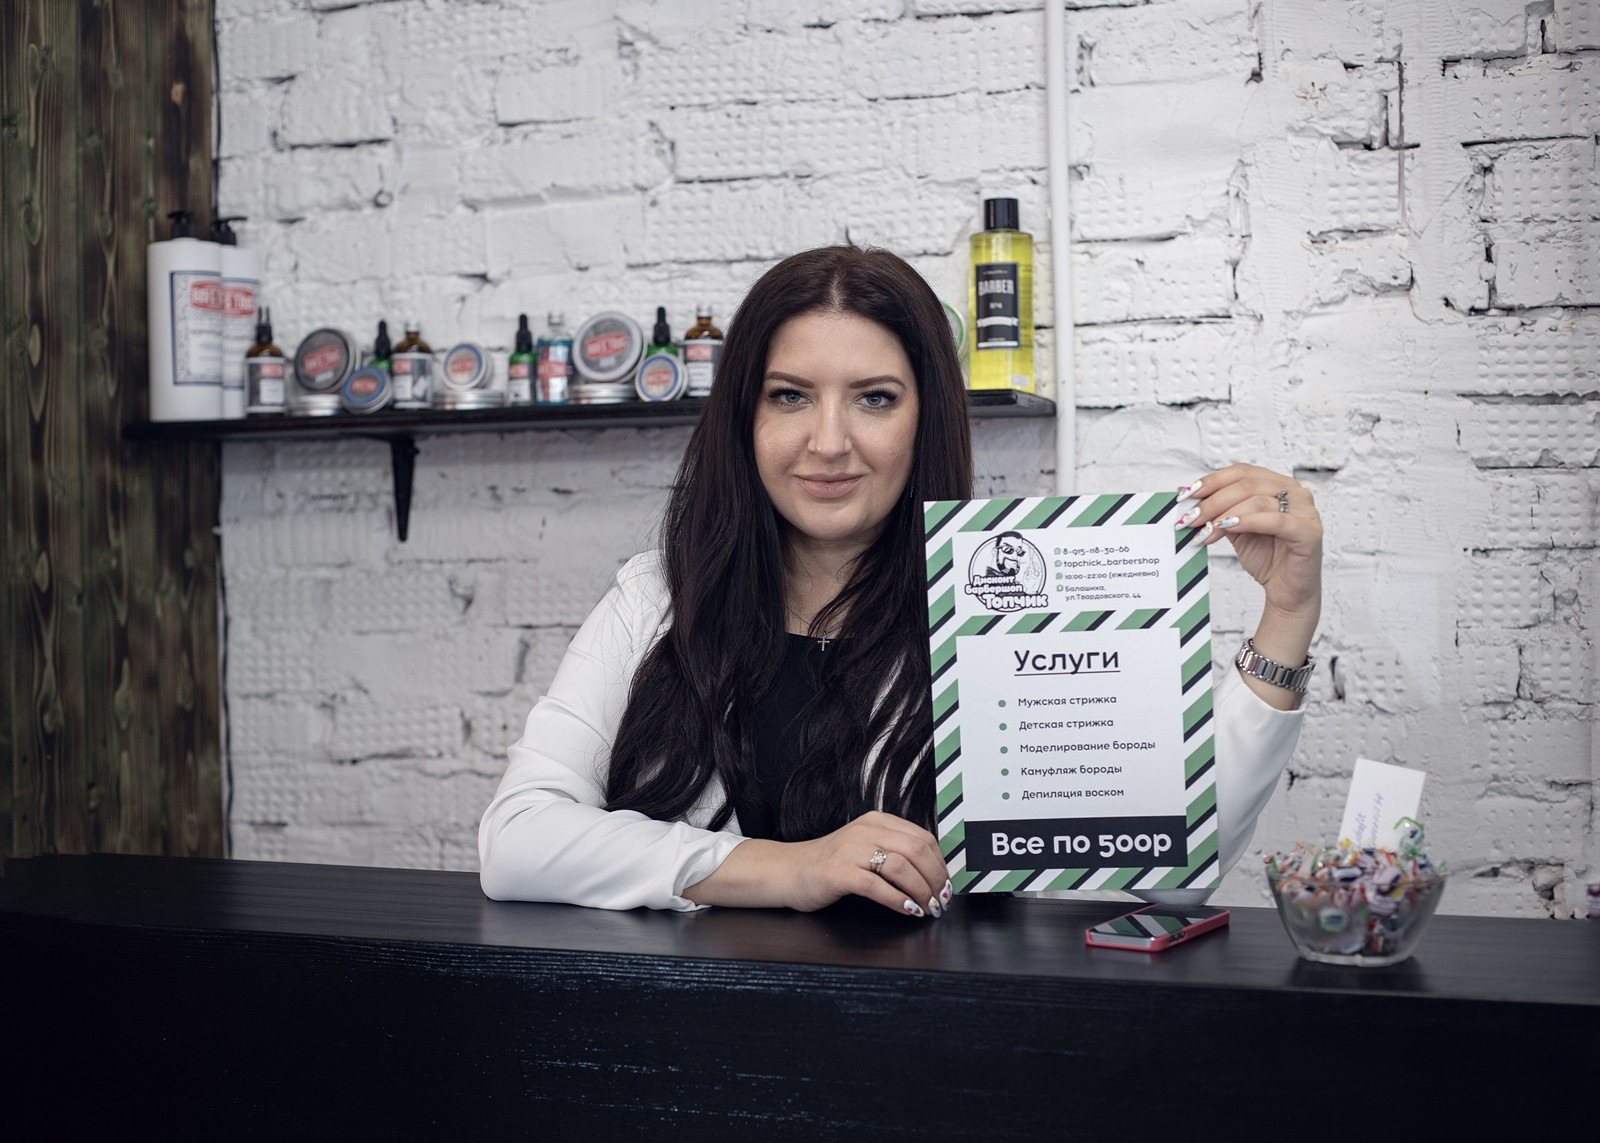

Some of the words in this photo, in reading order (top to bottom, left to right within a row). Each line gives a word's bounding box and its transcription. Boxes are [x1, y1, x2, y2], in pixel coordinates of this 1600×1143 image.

[1063, 546, 1130, 556] 8-915-118-30-66
[1064, 557, 1160, 568] topchick_barbershop
[973, 575, 1016, 587] Дисконт
[1109, 570, 1159, 580] (ежедневно)
[964, 584, 1024, 595] барбершоп
[981, 593, 1049, 610] Топчик
[1065, 592, 1131, 602] ул.Твардовского,
[1014, 650, 1120, 675] Услуги
[1018, 697, 1067, 709] Мужская
[1069, 696, 1117, 706] стрижка
[1018, 720, 1064, 732] Детская
[1066, 719, 1114, 730] стрижка
[1020, 742, 1110, 754] Моделирование
[1113, 740, 1156, 751] бороды
[1020, 766, 1077, 777] Камуфляж
[1079, 764, 1123, 775] бороды
[1021, 790, 1083, 801] Депиляция
[1085, 788, 1125, 798] воском
[991, 832, 1045, 856] Все
[1053, 834, 1091, 854] по
[1098, 832, 1172, 859] 500р
